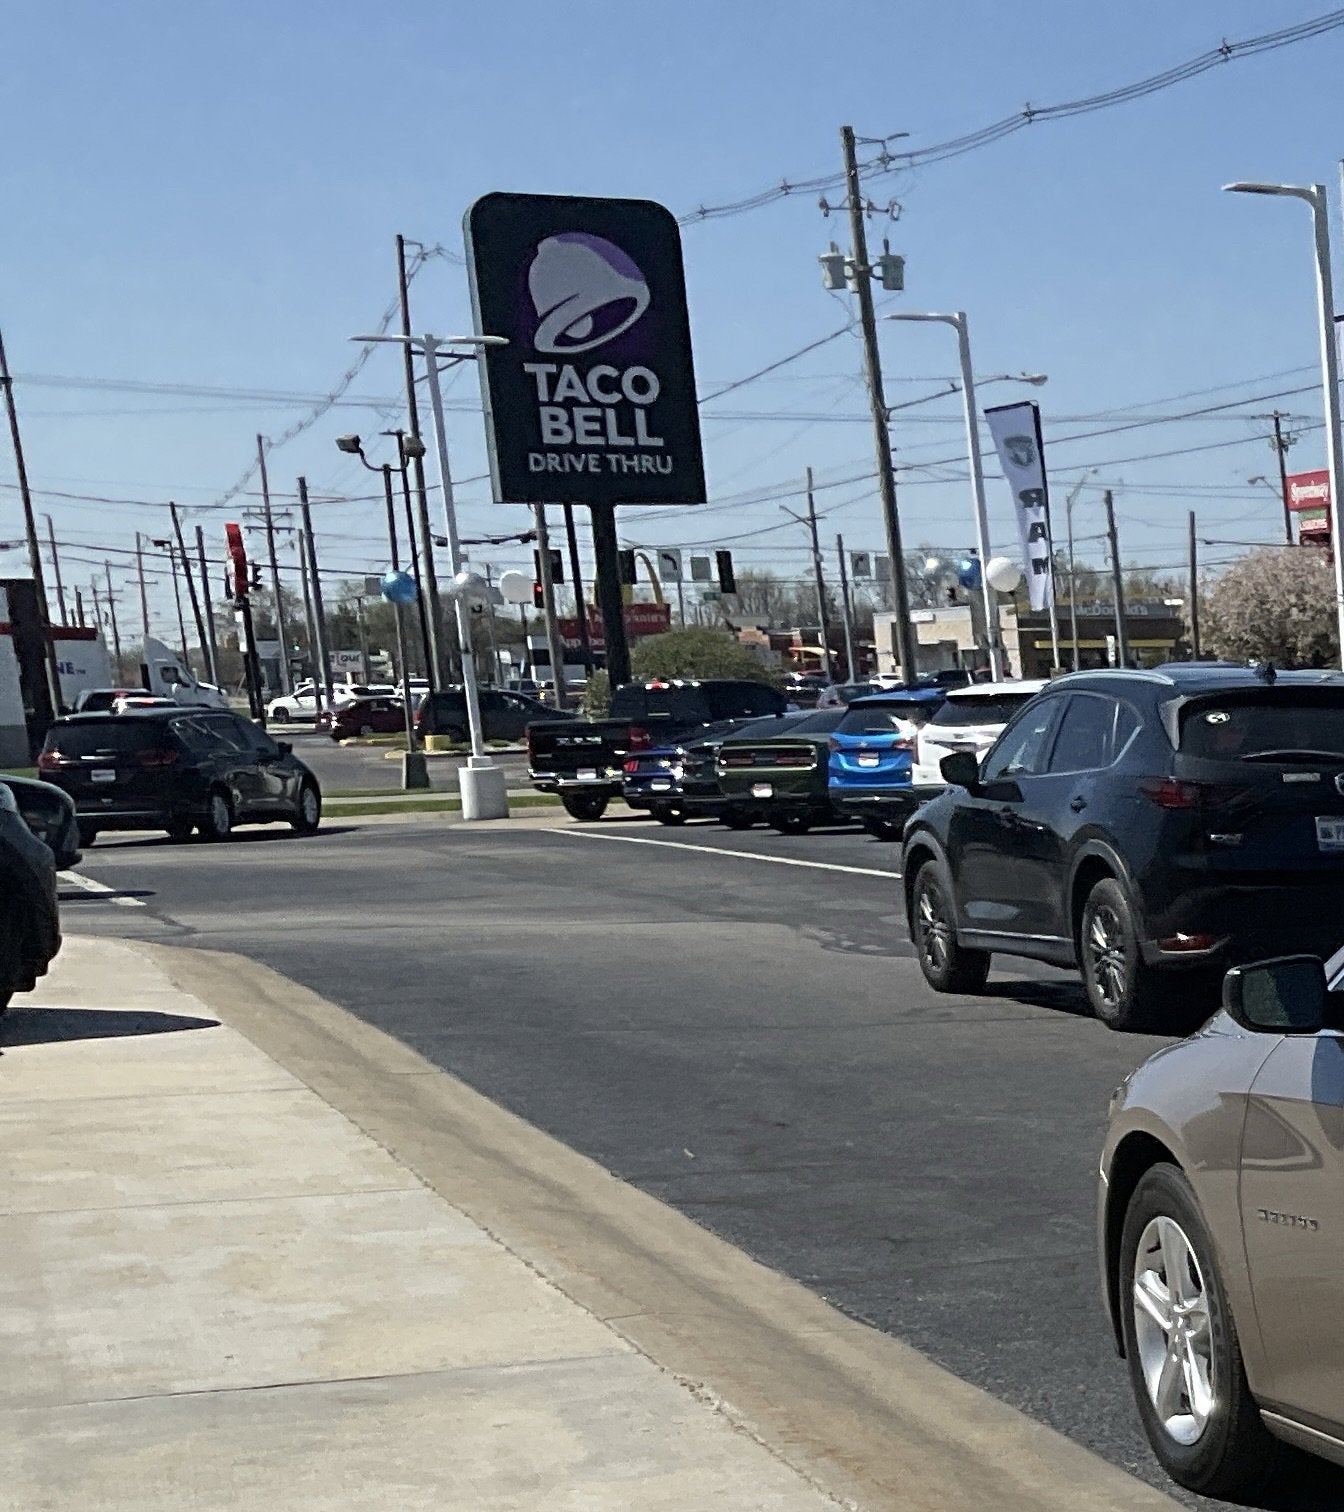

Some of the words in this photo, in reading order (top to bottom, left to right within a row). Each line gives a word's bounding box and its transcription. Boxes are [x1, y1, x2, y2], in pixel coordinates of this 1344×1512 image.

[523, 363, 660, 404] TACO
[539, 406, 664, 446] BELL
[528, 453, 601, 473] DRIVE
[606, 454, 673, 475] THRU
